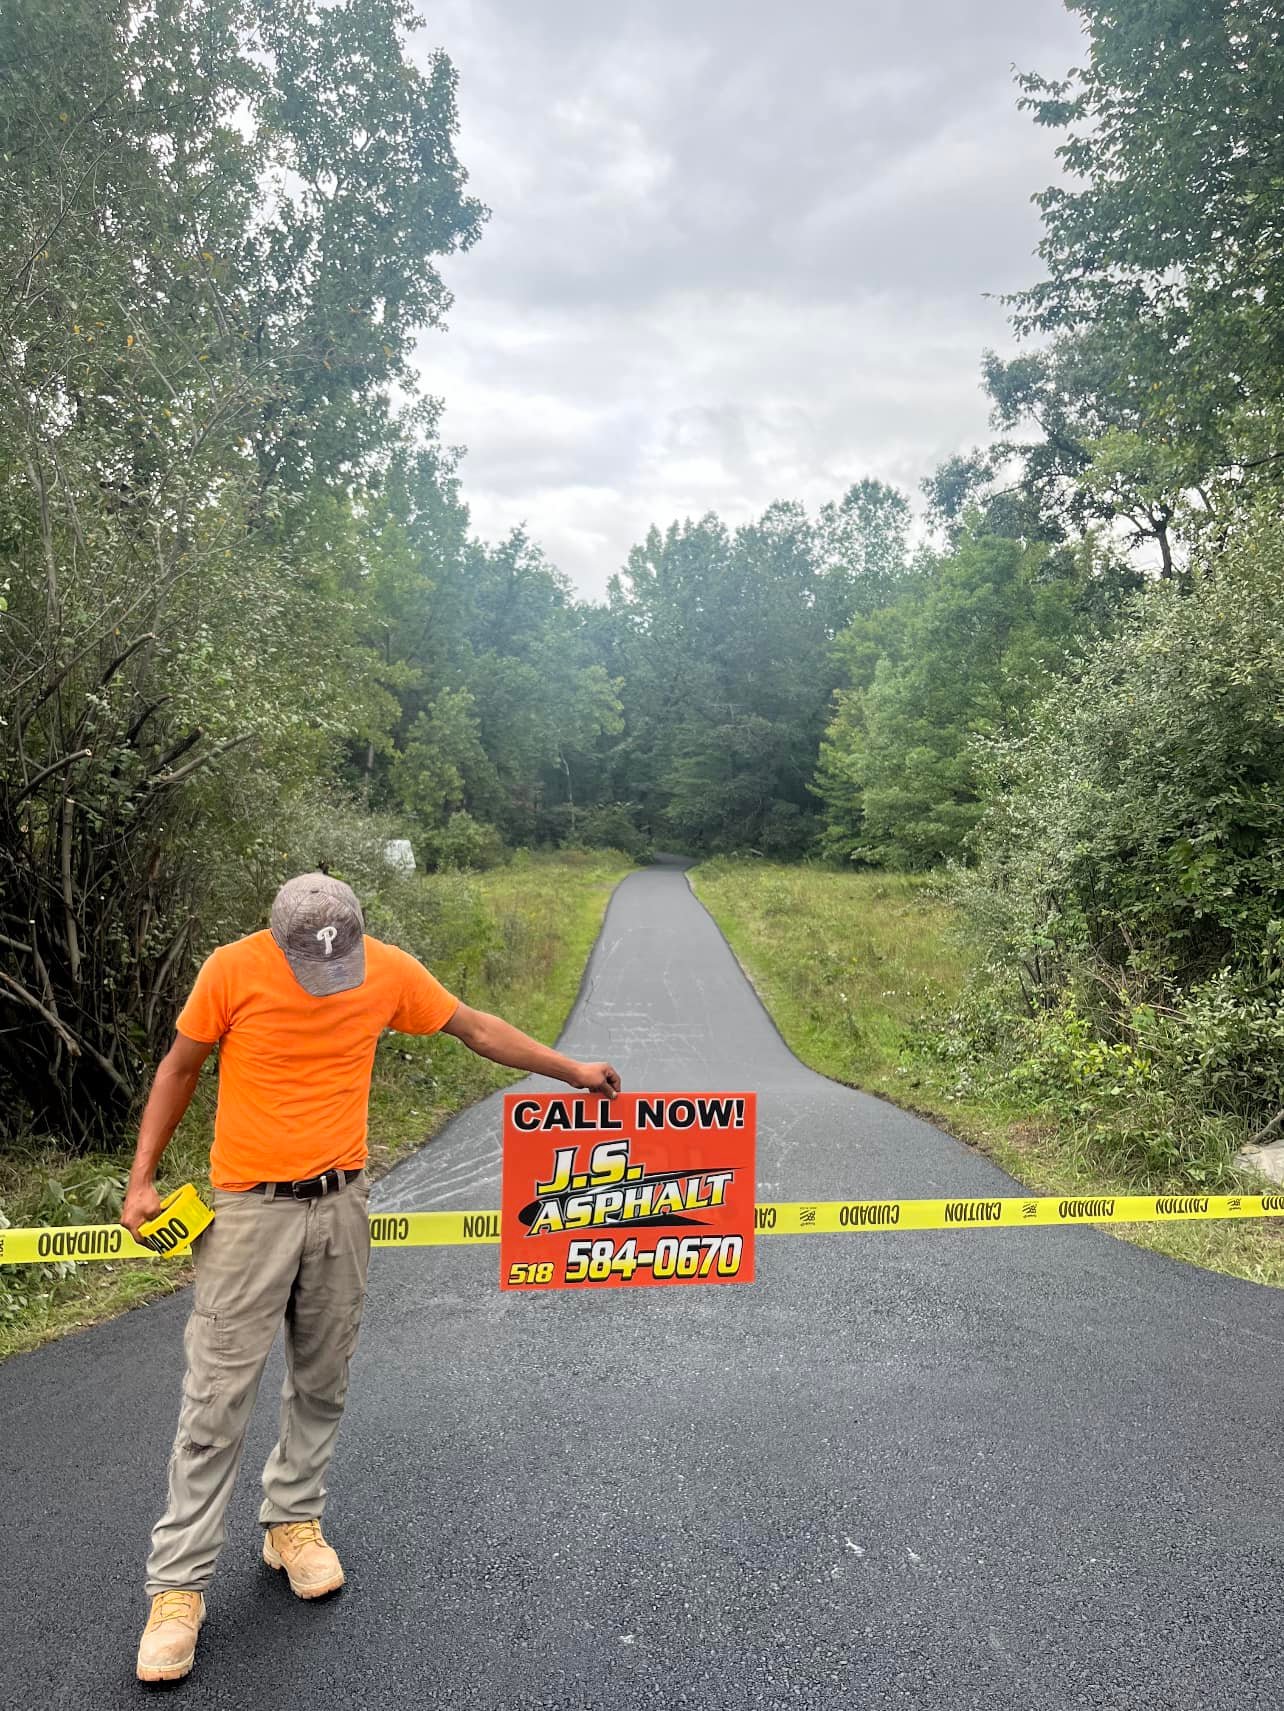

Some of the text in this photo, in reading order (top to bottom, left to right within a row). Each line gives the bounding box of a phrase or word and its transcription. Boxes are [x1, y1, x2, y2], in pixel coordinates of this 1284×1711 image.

[316, 926, 338, 955] P
[512, 1098, 745, 1131] CALL NOW!
[535, 1138, 644, 1196] J.S.
[526, 1170, 734, 1237] ASPHALT
[839, 1204, 900, 1226] CUIDADO
[944, 1202, 1002, 1223] CAUTION
[1058, 1199, 1115, 1218] CUIDADO
[1155, 1197, 1209, 1214] CAUTION
[369, 1217, 409, 1241] CUID
[463, 1215, 500, 1238] TION
[38, 1229, 122, 1257] CUIDADO
[508, 1233, 744, 1286] 518 584-0670
